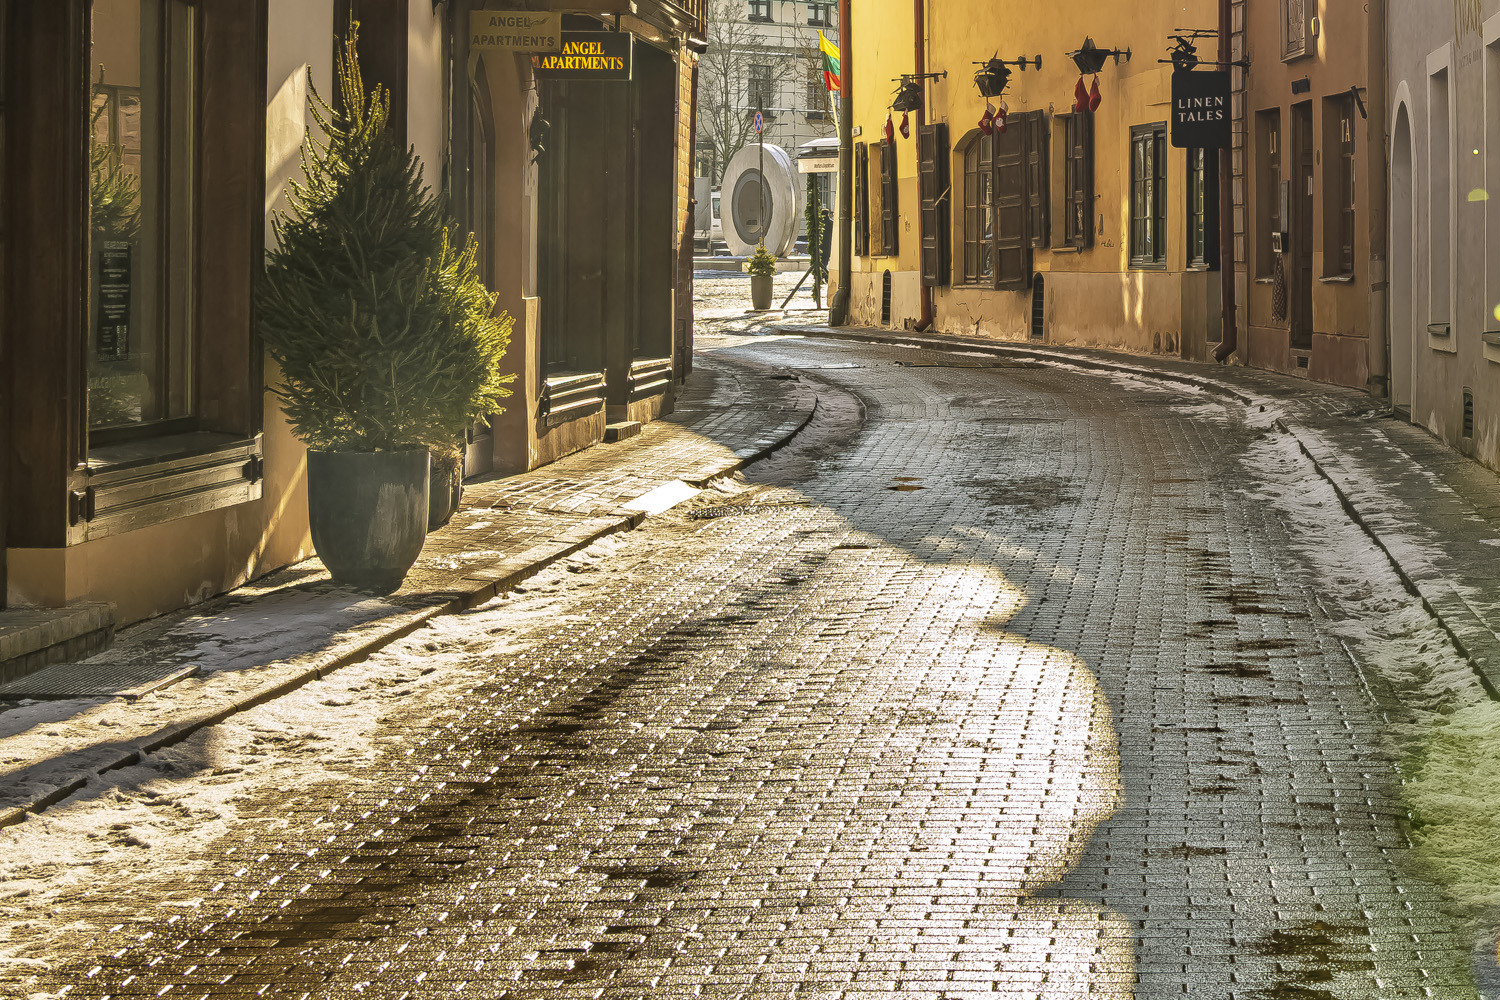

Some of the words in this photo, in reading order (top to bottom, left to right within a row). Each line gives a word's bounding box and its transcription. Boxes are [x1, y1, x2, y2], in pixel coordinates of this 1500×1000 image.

[489, 17, 531, 28] ANGEL
[472, 35, 555, 47] APARTMENTS
[562, 41, 605, 55] ANGEL
[541, 56, 624, 70] APARTMENTS
[1178, 96, 1224, 109] LINEN
[1178, 110, 1224, 123] TALES
